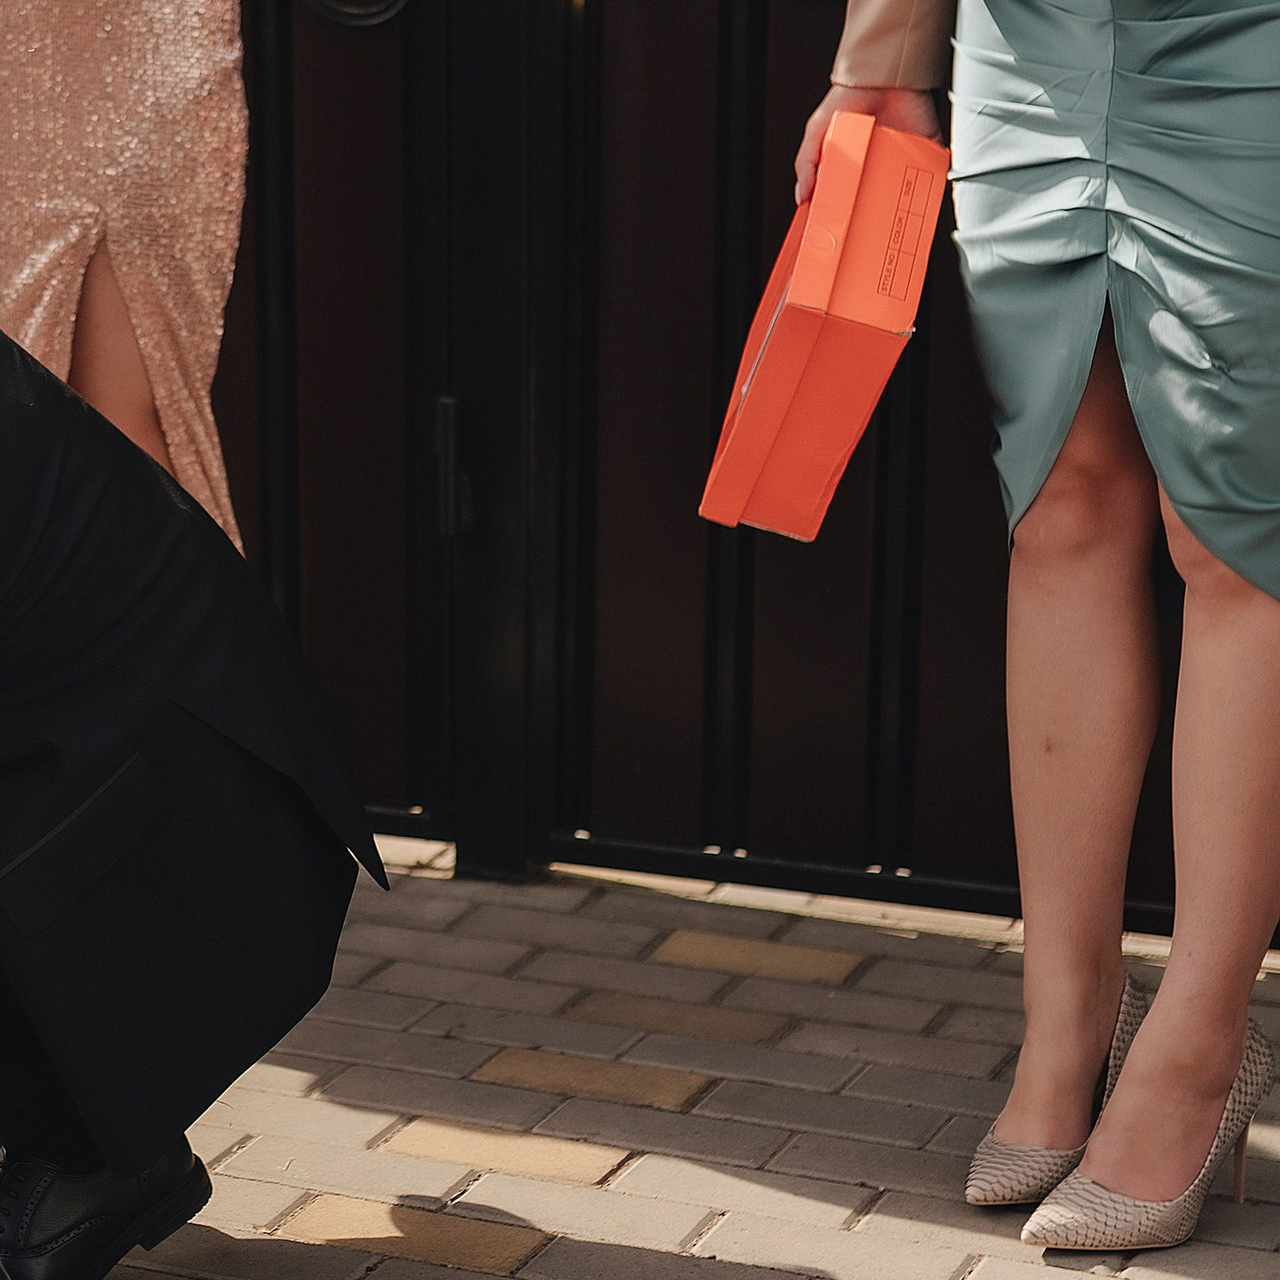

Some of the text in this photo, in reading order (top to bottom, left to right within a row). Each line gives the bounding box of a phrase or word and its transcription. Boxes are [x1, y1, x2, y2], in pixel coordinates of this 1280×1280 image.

[904, 180, 912, 197] SIZE
[893, 217, 904, 245] COLOR
[881, 253, 896, 293] STYLE NO
